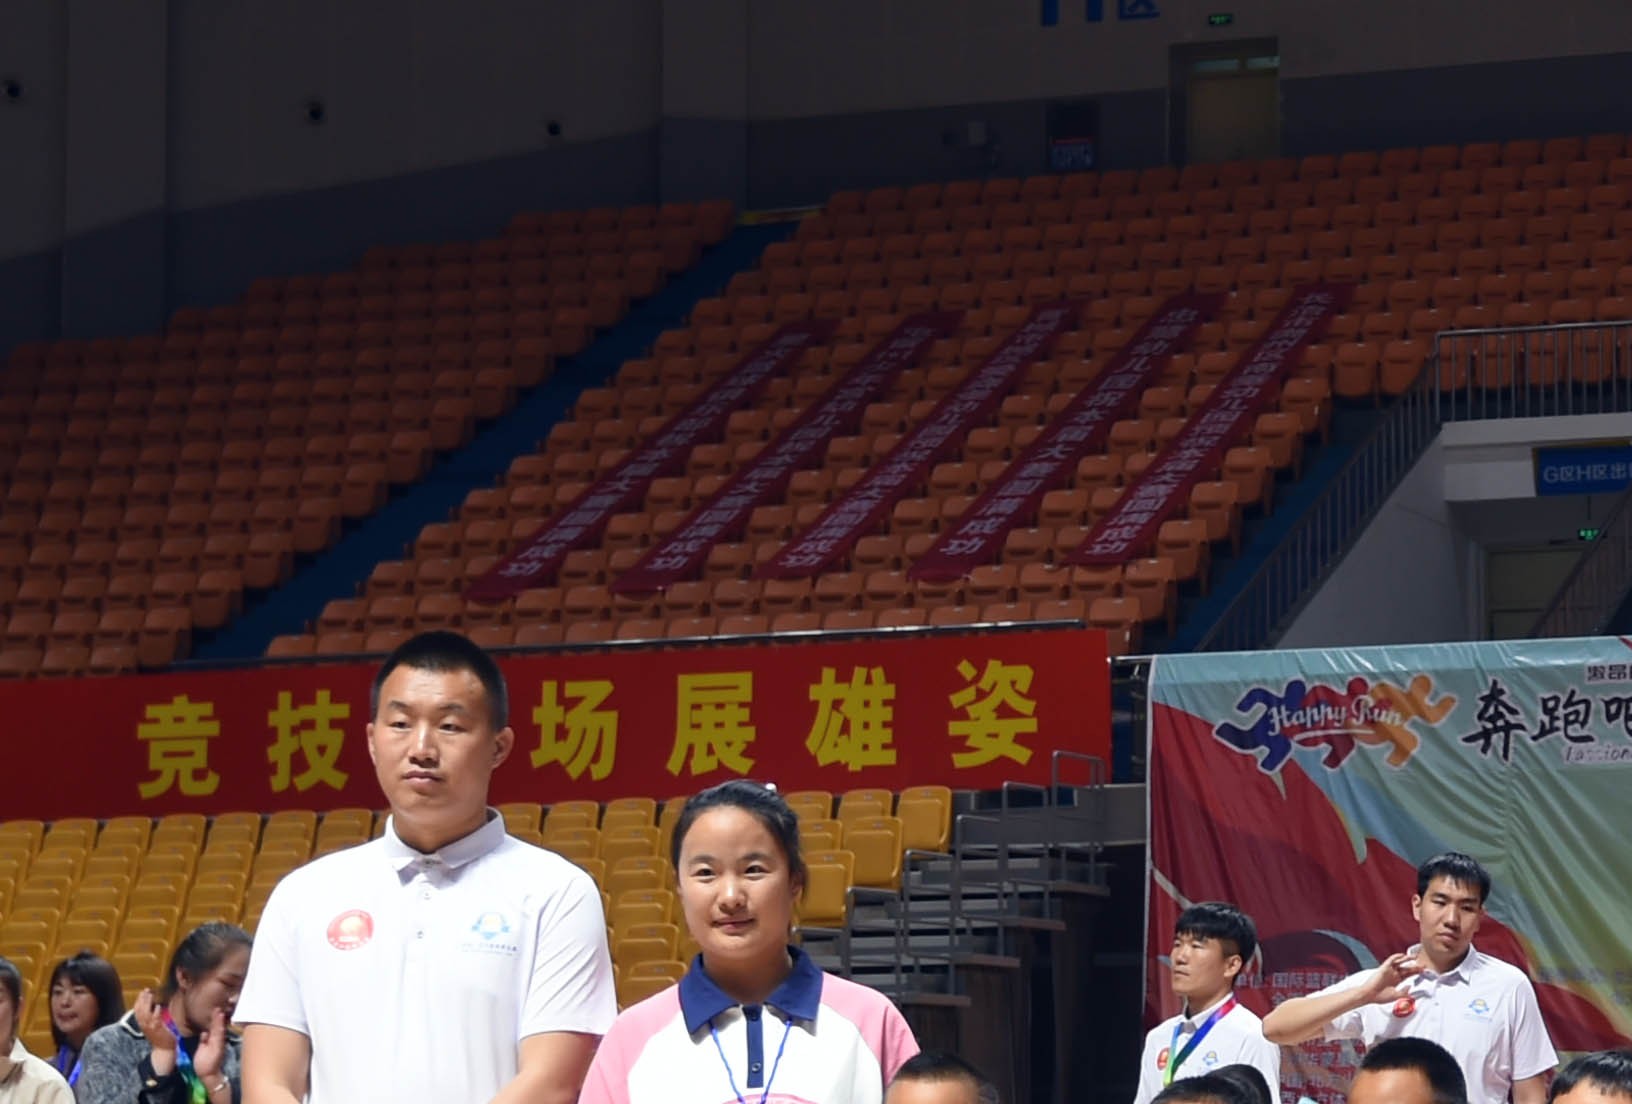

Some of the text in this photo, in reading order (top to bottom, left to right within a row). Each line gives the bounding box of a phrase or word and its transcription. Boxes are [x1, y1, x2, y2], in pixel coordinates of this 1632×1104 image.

[136, 658, 1041, 798] 竞技场展雄姿
[1267, 694, 1402, 736] Happy Run
